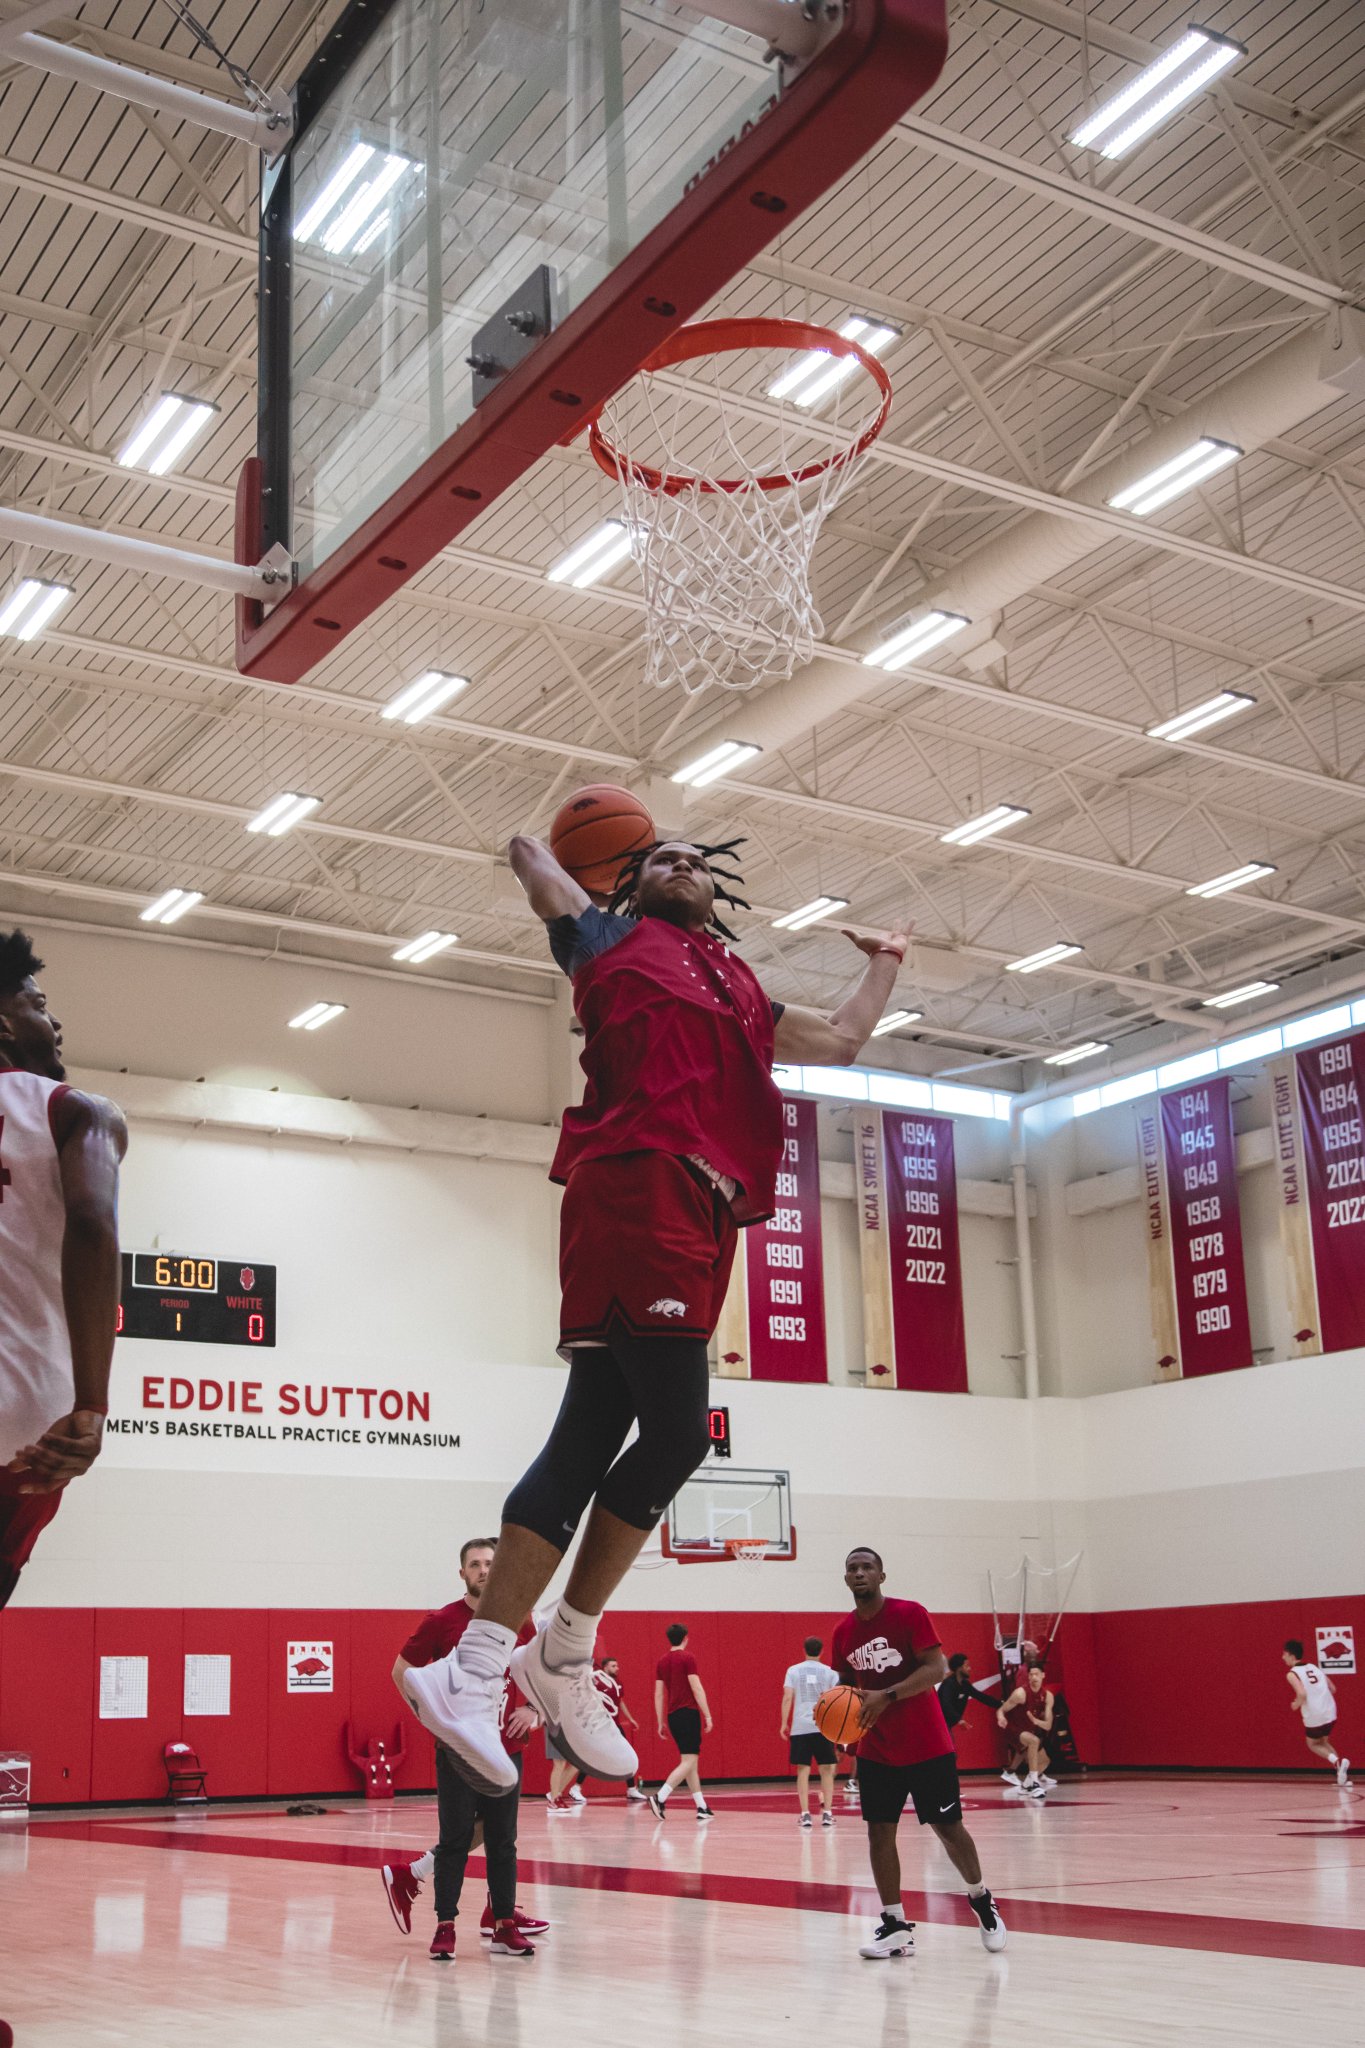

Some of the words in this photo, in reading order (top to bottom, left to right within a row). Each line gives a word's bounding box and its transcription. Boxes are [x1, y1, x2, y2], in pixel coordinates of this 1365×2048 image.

[1319, 1043, 1352, 1076] 1991
[1179, 1089, 1209, 1120] 1941
[1273, 1074, 1289, 1114] EIGHT
[1319, 1080, 1359, 1114] 1994
[861, 1125, 874, 1139] 16
[901, 1121, 936, 1148] 1994
[1141, 1116, 1157, 1155] EIGHT
[1180, 1124, 1215, 1155] 1945
[1279, 1120, 1296, 1164] ELITE
[1322, 1118, 1362, 1152] 1995
[863, 1144, 879, 1189] SWEET
[903, 1155, 937, 1182] 1995
[1146, 1159, 1161, 1198] ELITE
[1183, 1160, 1218, 1191] 1949
[1326, 1156, 1365, 1191] 2021
[1285, 1168, 1300, 1206] NCAA
[865, 1196, 880, 1231] NCAA
[905, 1190, 939, 1216] 1996
[1186, 1196, 1221, 1227] 1958
[1150, 1200, 1163, 1240] NCAA
[906, 1224, 942, 1250] 2021
[1189, 1232, 1224, 1263] 1978
[766, 1243, 803, 1269] 1990
[906, 1258, 946, 1285] 2022
[155, 1257, 213, 1289] 6:00
[1192, 1268, 1228, 1299] 1979
[160, 1298, 190, 1310] PERIOD
[226, 1295, 263, 1311] WHITE
[770, 1279, 802, 1305] 1991
[176, 1312, 182, 1332] 1
[248, 1313, 264, 1341] 0
[768, 1315, 806, 1342] 1993
[1195, 1304, 1231, 1335] 1990
[142, 1375, 264, 1415] EDDIE
[278, 1383, 431, 1422] SUTTON
[106, 1418, 160, 1435] MEN'S
[166, 1421, 277, 1440] BASKETBALL
[282, 1426, 361, 1444] PRACTICE
[366, 1430, 461, 1448] GYMNASIUM
[710, 1411, 725, 1439] 0
[1305, 1670, 1318, 1684] 5
